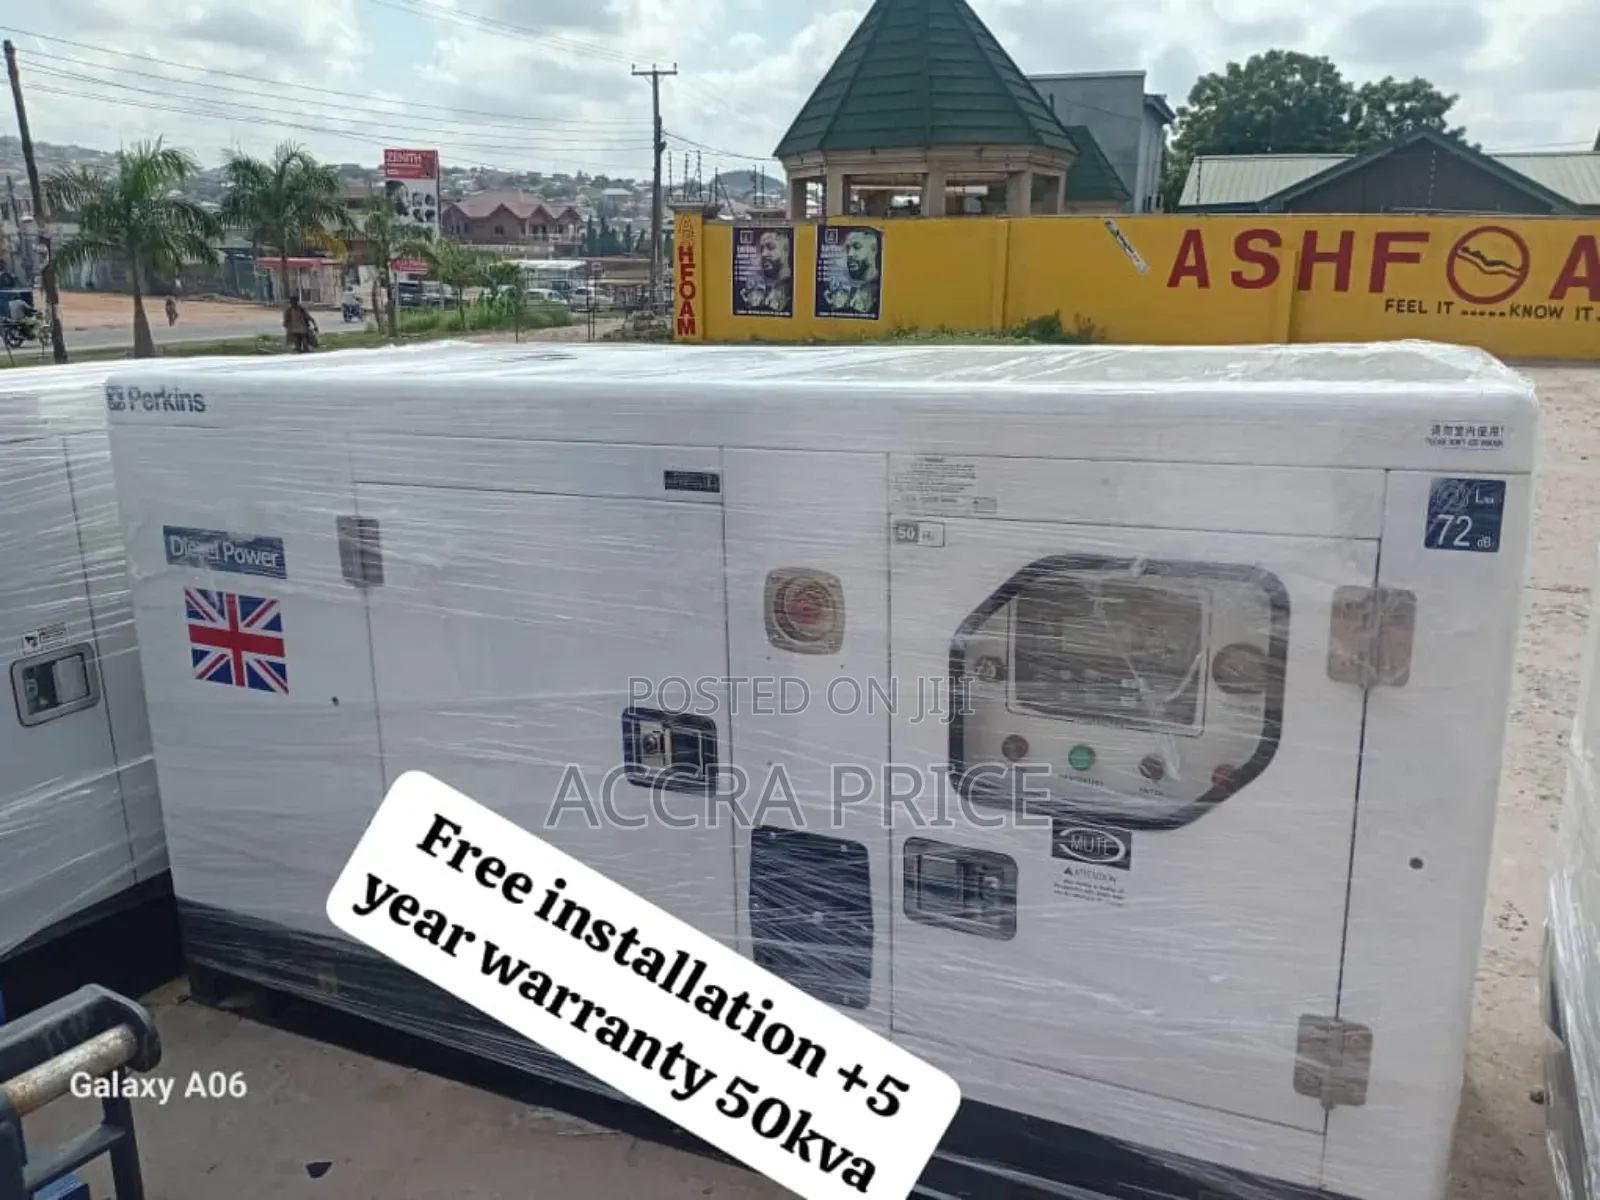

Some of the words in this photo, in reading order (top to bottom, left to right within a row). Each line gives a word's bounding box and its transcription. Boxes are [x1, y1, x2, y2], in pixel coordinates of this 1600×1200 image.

[1384, 299, 1428, 315] FEEL
[1437, 301, 1455, 315] IT
[127, 384, 207, 413] Perkins
[897, 526, 917, 541] 50
[1437, 513, 1474, 547] 72
[169, 535, 220, 561] Dieel
[222, 540, 279, 568] Power
[1070, 833, 1118, 857] MUTE
